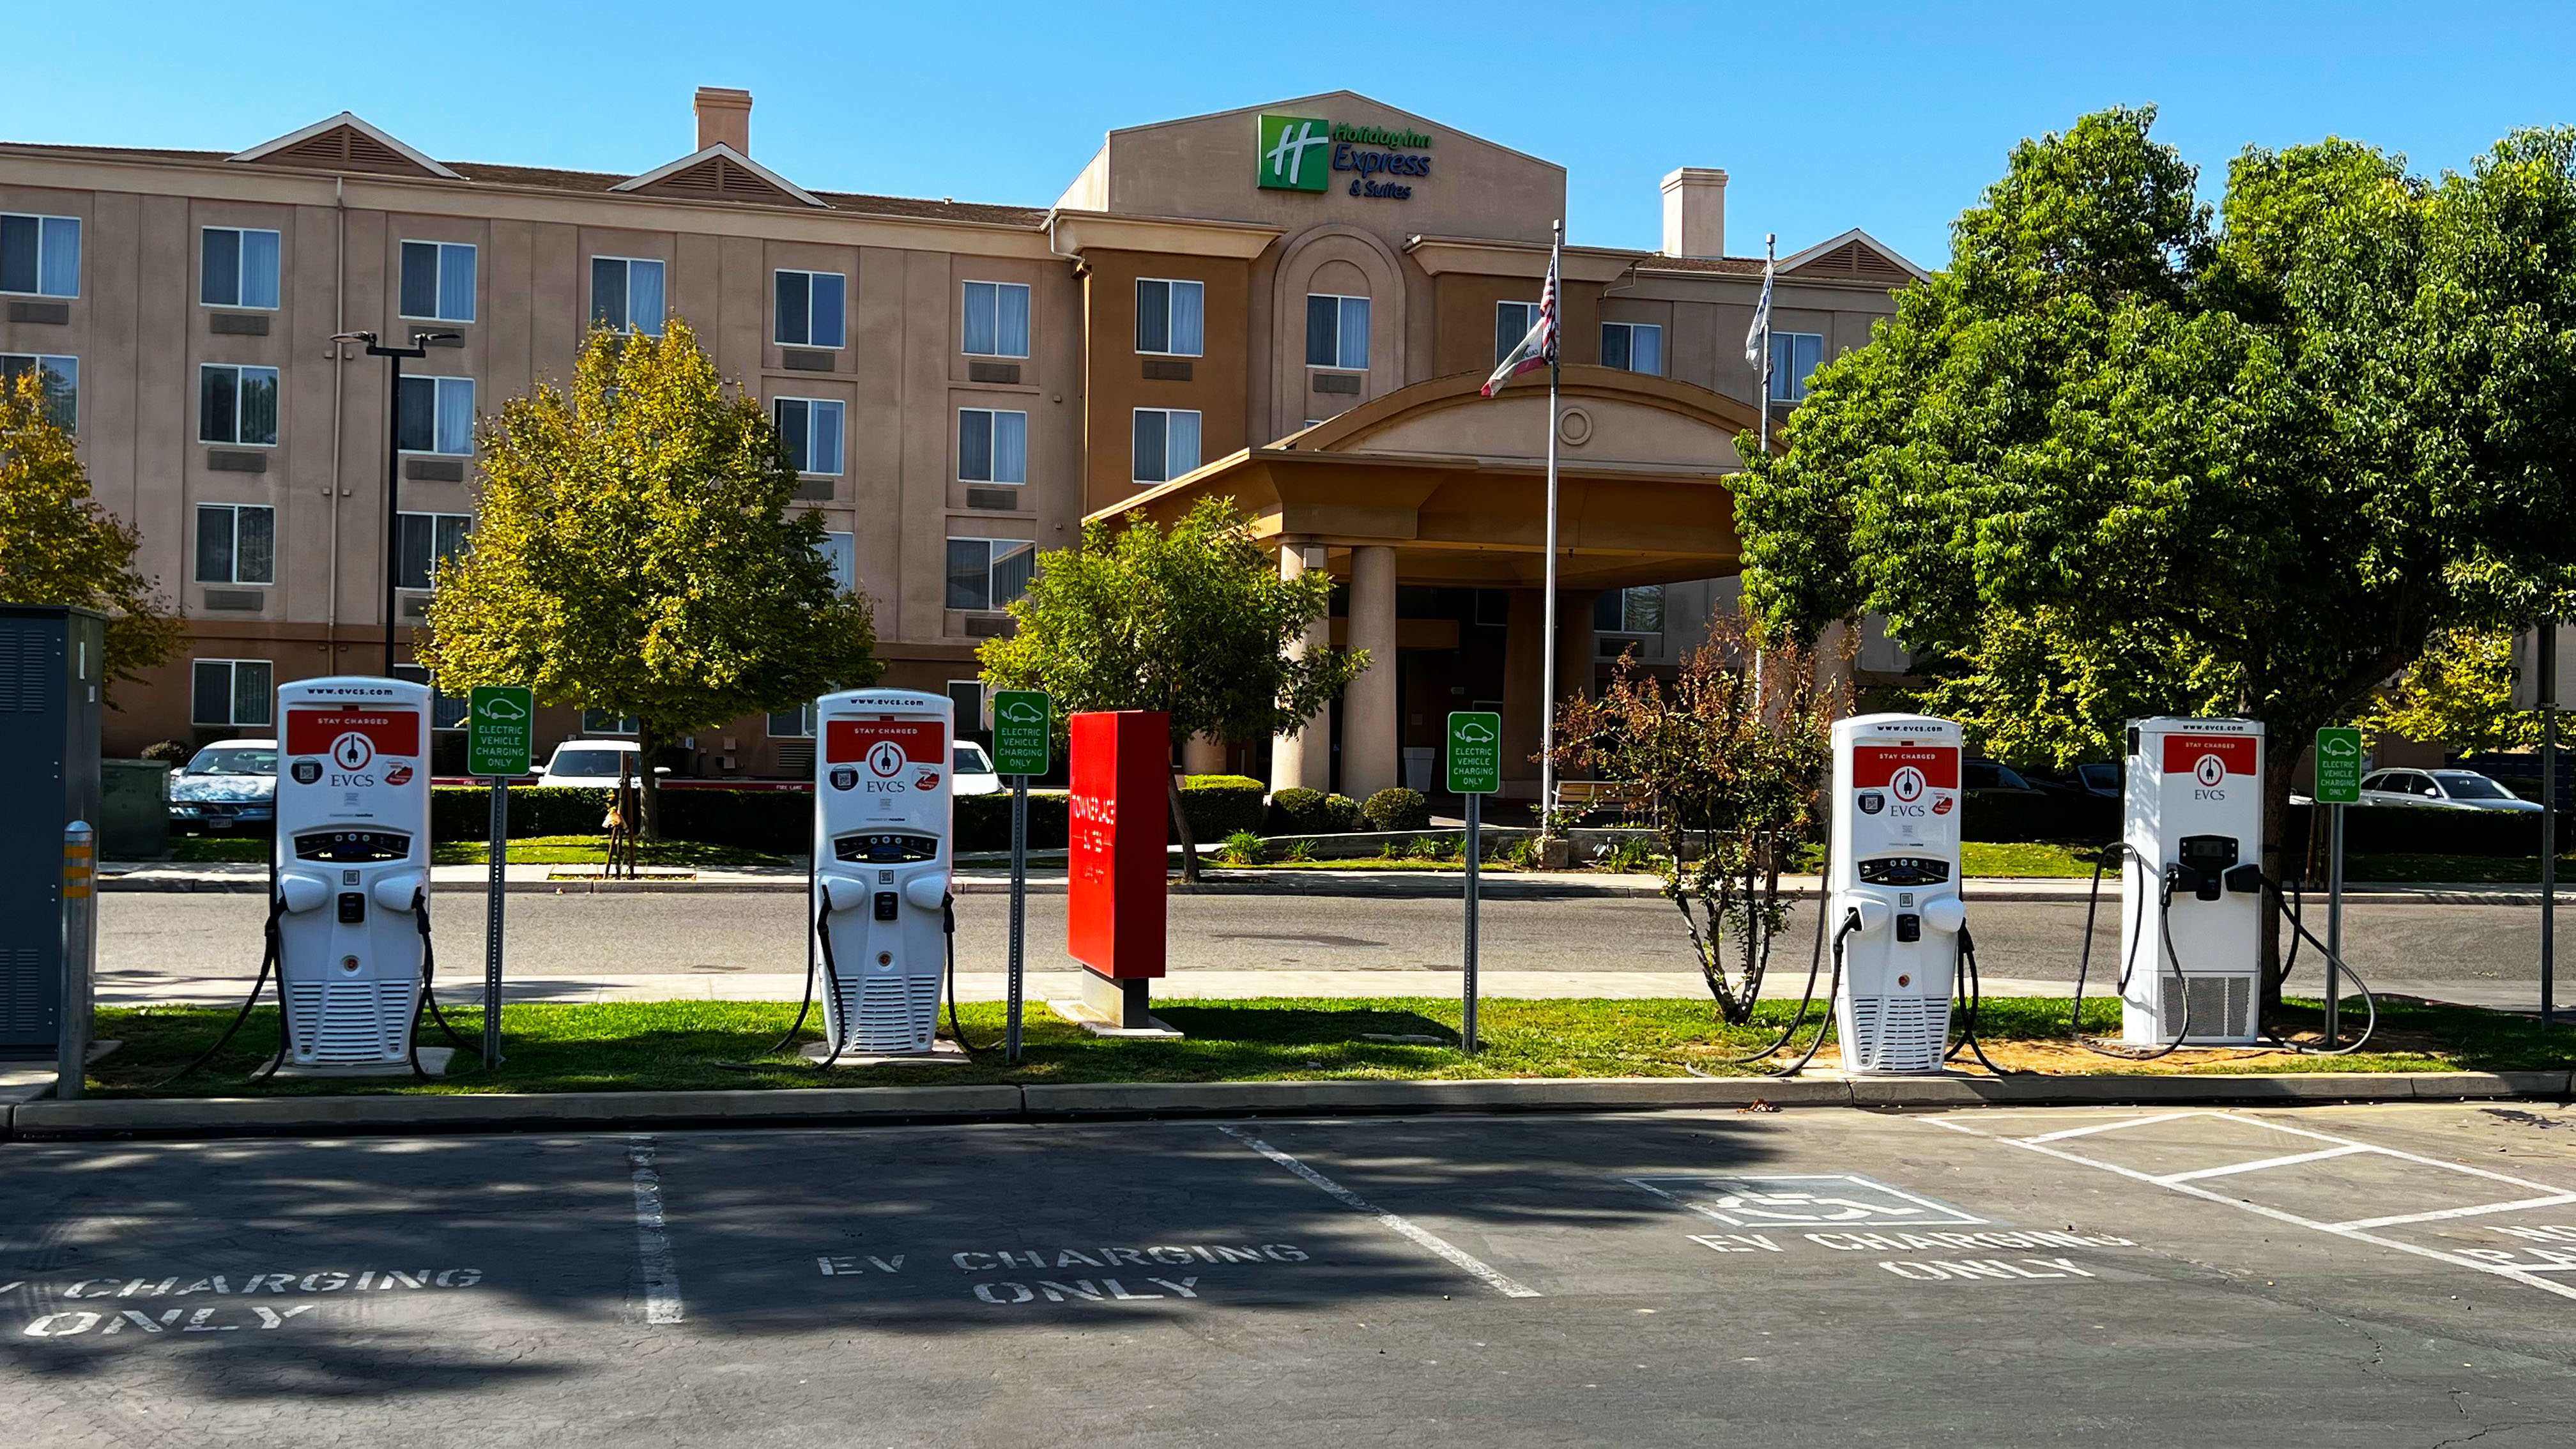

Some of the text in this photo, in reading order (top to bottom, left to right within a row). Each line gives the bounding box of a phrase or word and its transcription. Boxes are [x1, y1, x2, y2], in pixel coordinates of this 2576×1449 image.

[1333, 123, 1433, 150] Holiday Inn
[1333, 144, 1431, 178] Express
[1349, 179, 1412, 199] & Suites
[479, 725, 523, 735] ELECTRIC
[1002, 728, 1041, 737] ELECTRIC
[481, 737, 521, 746] VEHICLE
[1004, 738, 1039, 746] VEHICLE
[476, 747, 525, 756] CHARGING
[999, 748, 1043, 757] CHARGING
[487, 758, 512, 767] ONLY
[331, 774, 374, 787] EVCS
[866, 781, 905, 793] EVCS
[2195, 790, 2225, 801] EVCS
[1890, 805, 1925, 817] EVCS
[1685, 1230, 2137, 1253] EV CHARGING
[817, 1244, 1310, 1276] EV CHARGING
[1878, 1258, 2096, 1280] ONLY
[64, 1268, 483, 1298] CHARGING
[972, 1276, 1199, 1304] ONLY
[24, 1305, 314, 1336] ONLY
